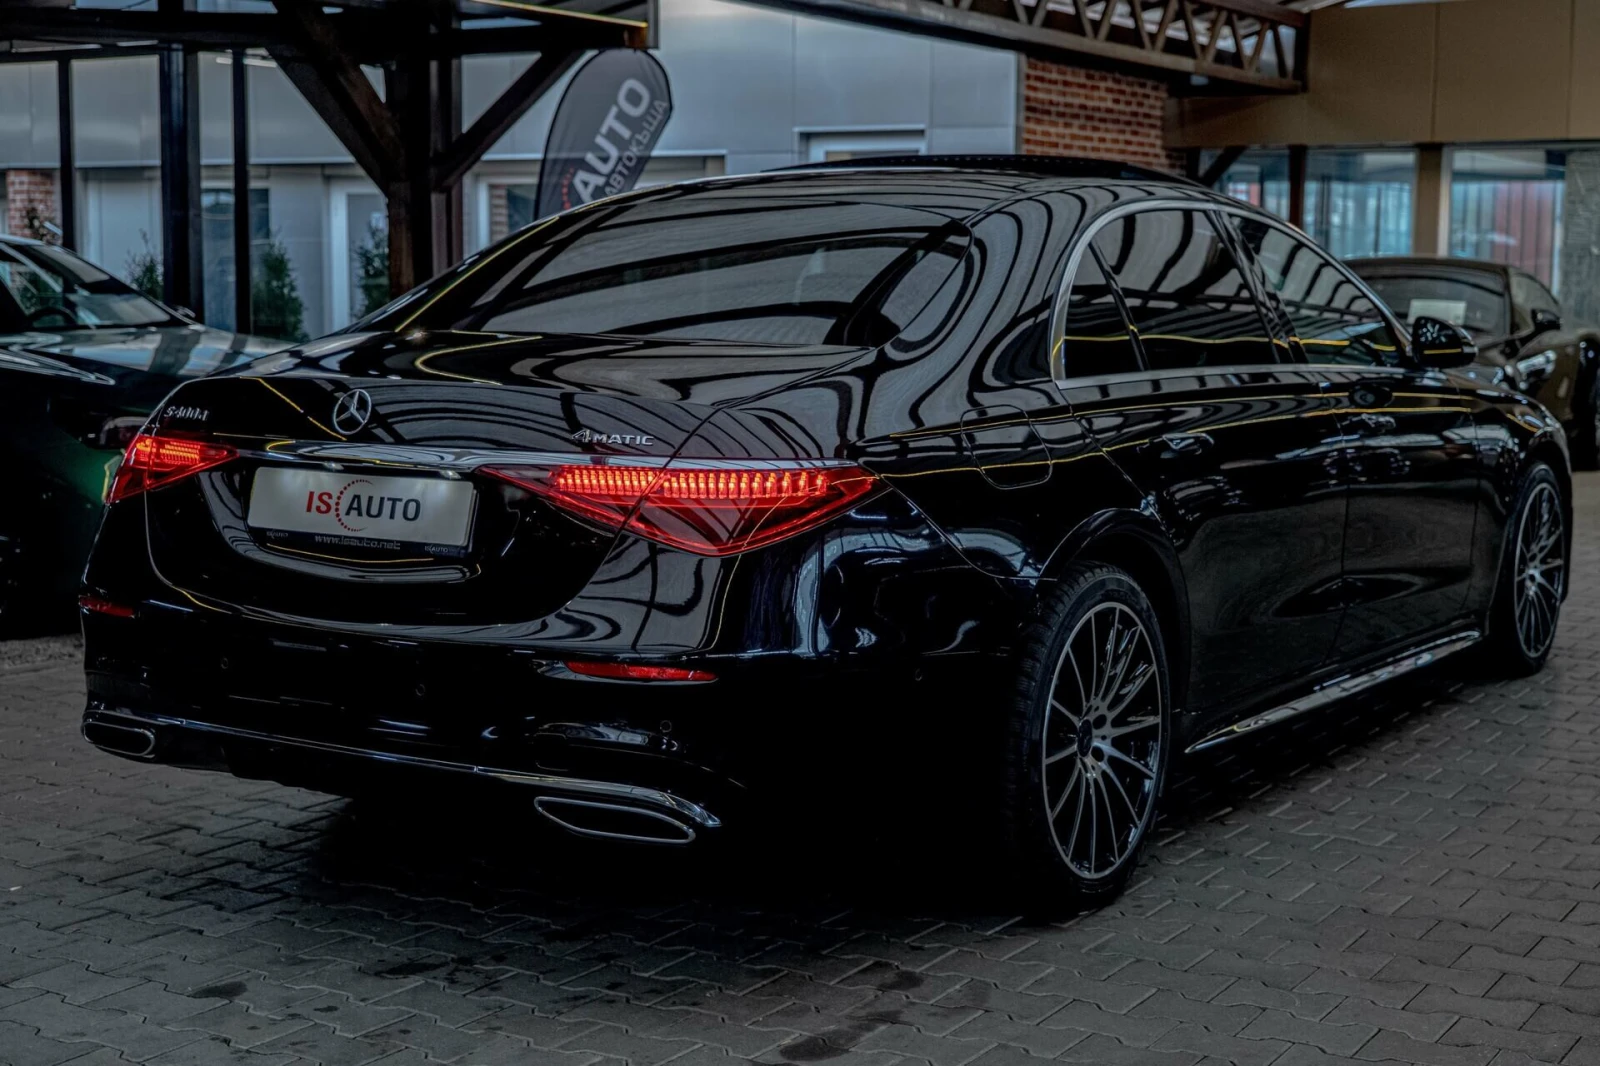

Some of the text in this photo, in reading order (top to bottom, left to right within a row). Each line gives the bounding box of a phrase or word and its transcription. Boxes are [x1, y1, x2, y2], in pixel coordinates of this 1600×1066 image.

[573, 78, 652, 203] AUTO
[571, 429, 655, 445] 4MATIC
[306, 491, 421, 521] IS AUTO
[314, 534, 401, 550] www.isauto.net
